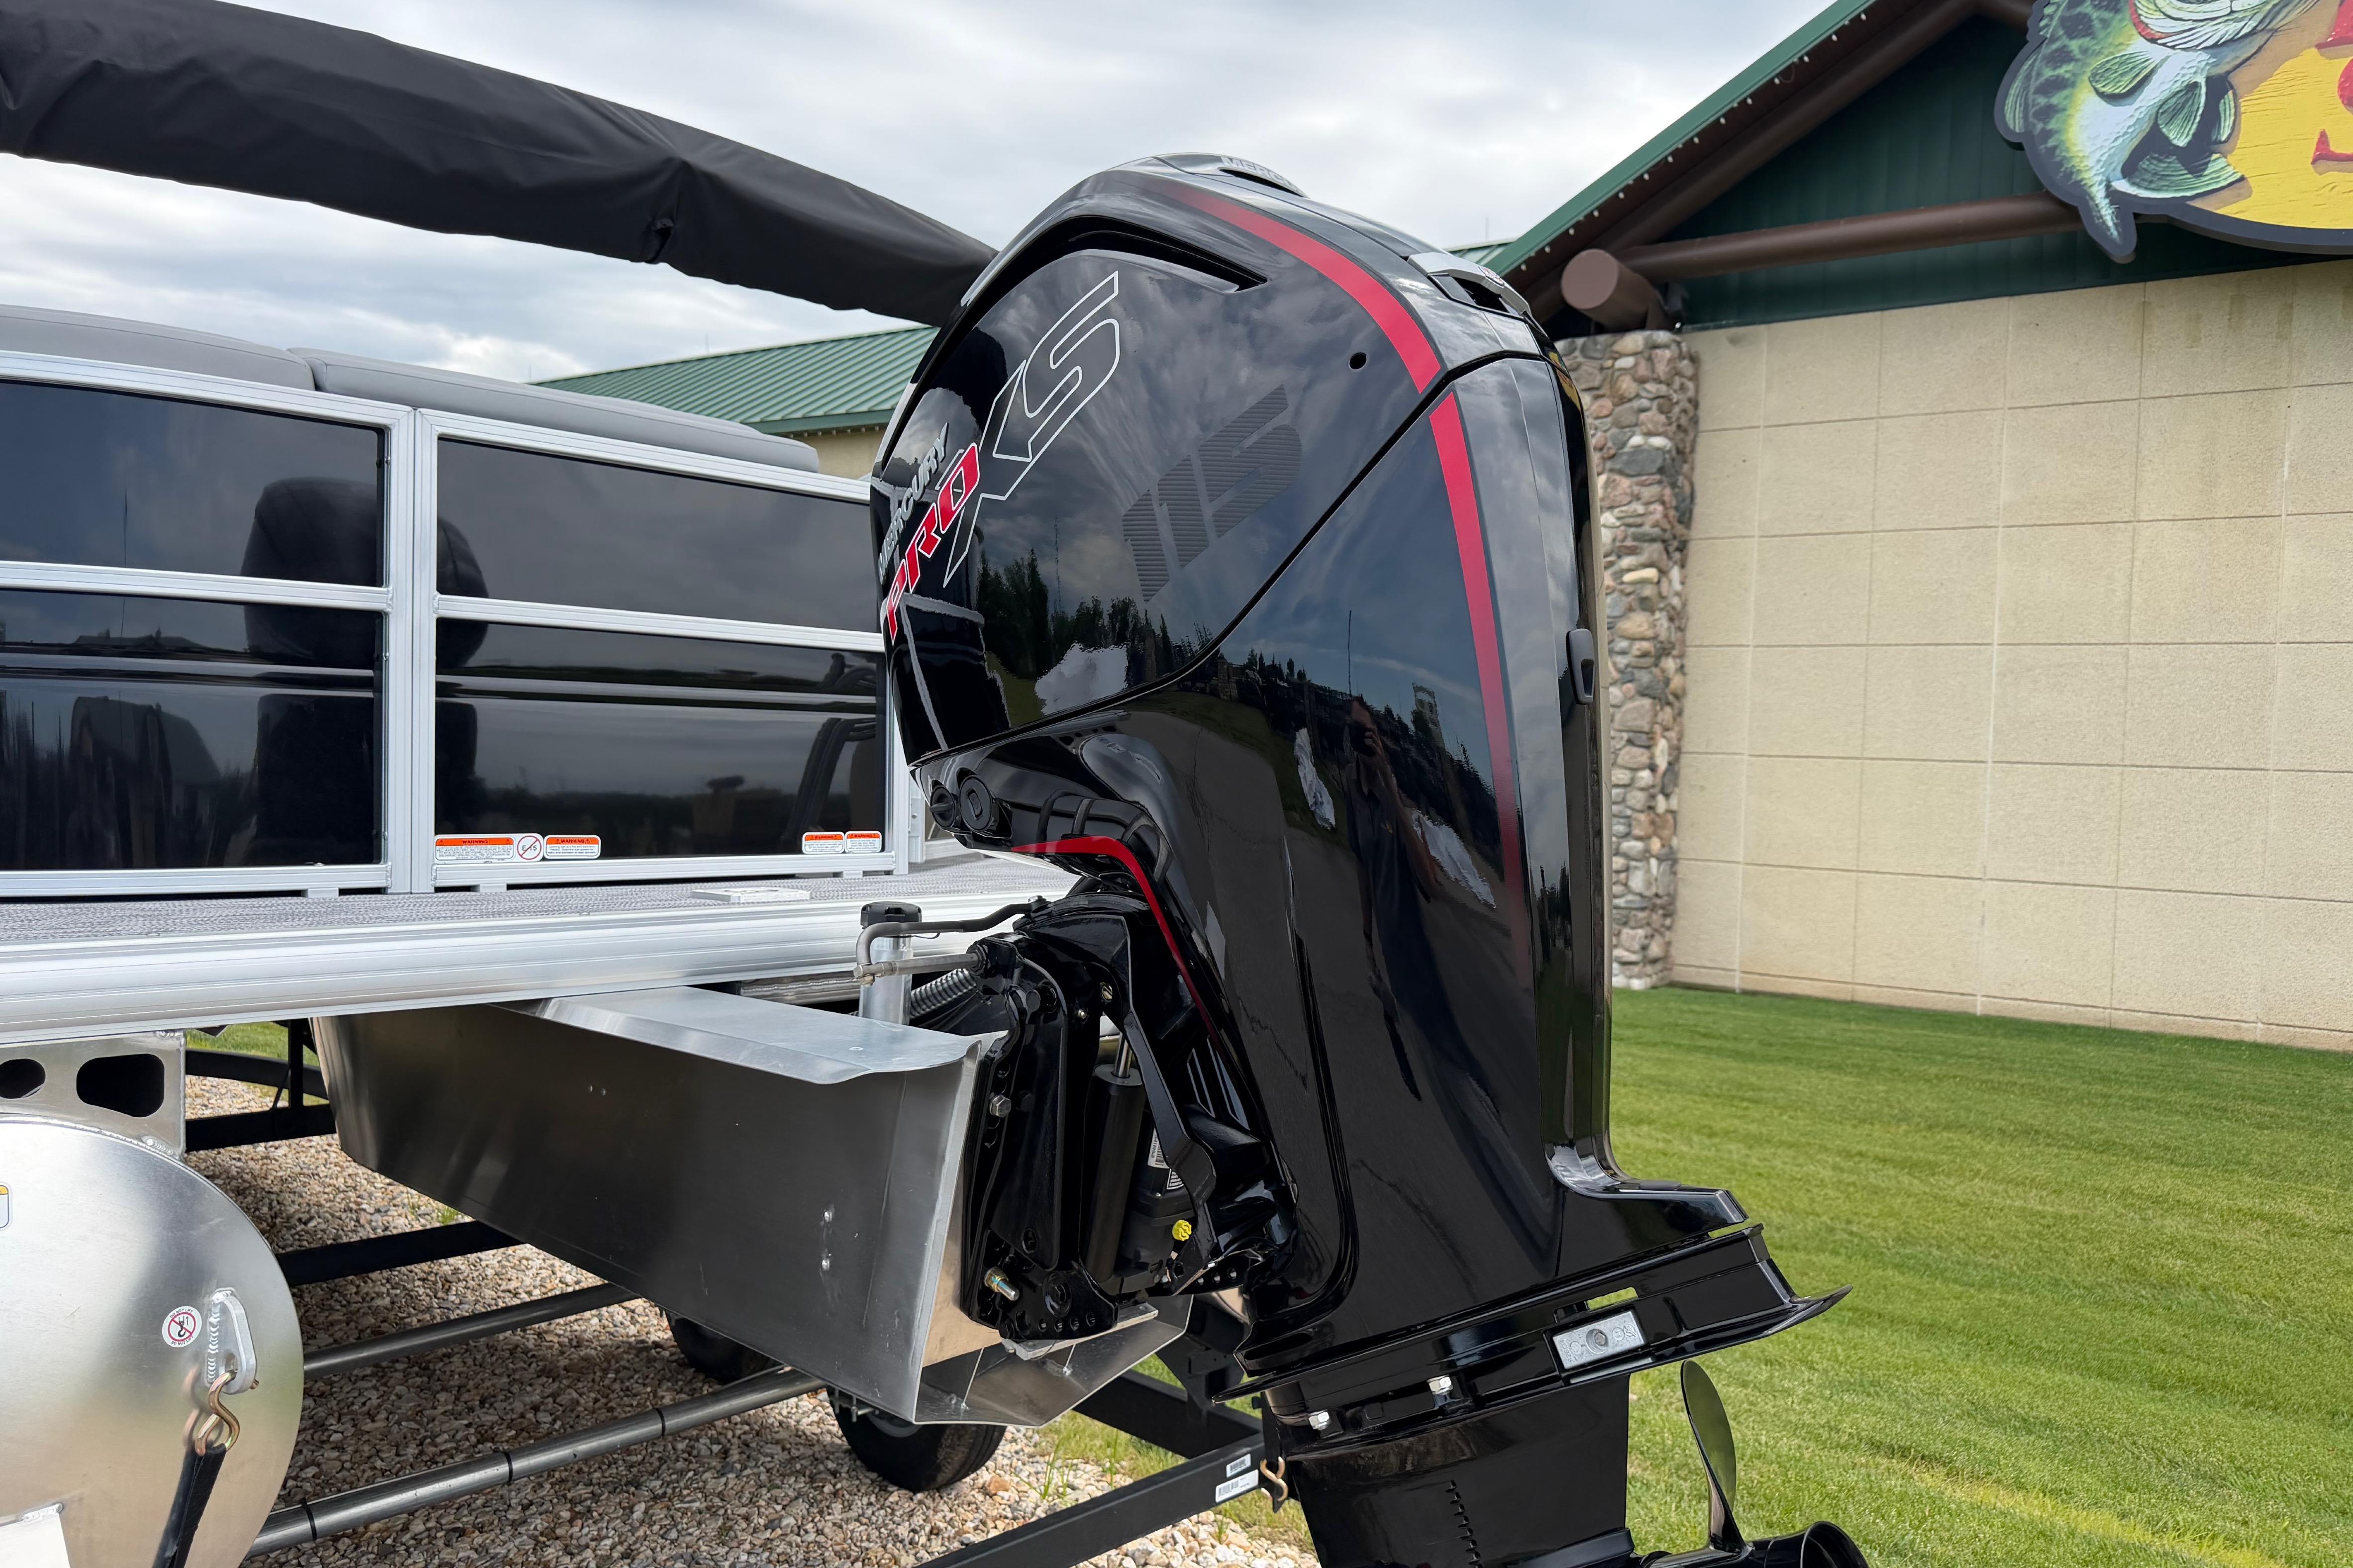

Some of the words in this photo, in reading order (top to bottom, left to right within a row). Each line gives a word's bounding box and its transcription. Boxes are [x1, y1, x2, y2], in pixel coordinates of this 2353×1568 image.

[878, 422, 949, 586] MERCURY
[886, 442, 980, 646] PRO
[1122, 384, 1302, 602] 115
